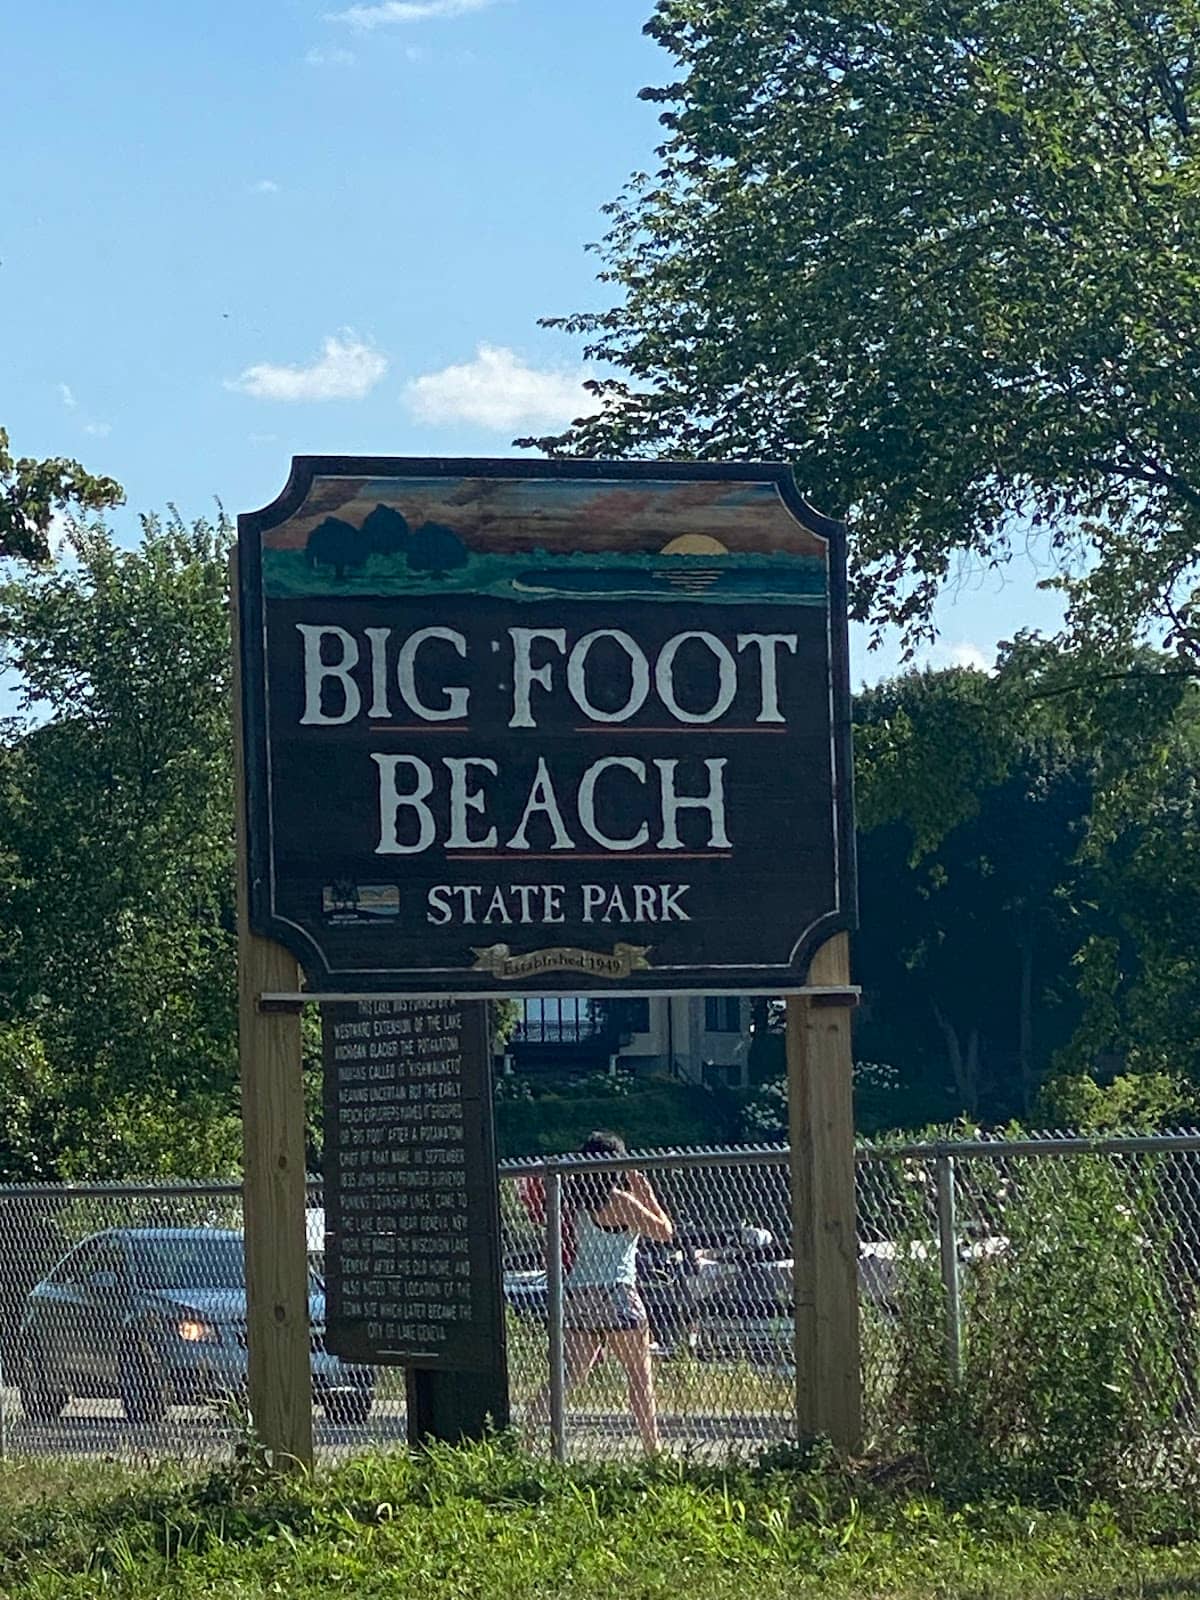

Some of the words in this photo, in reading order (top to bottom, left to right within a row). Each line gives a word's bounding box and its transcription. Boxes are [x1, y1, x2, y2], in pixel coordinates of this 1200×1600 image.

[296, 623, 470, 726] BIG
[507, 626, 798, 728] FOOT
[370, 752, 733, 855] BEACH
[426, 884, 566, 925] STATE
[581, 884, 692, 925] PARK
[503, 953, 585, 976] Established
[589, 956, 622, 975] 1949
[427, 1014, 441, 1031] THE
[443, 1012, 462, 1030] LAKE
